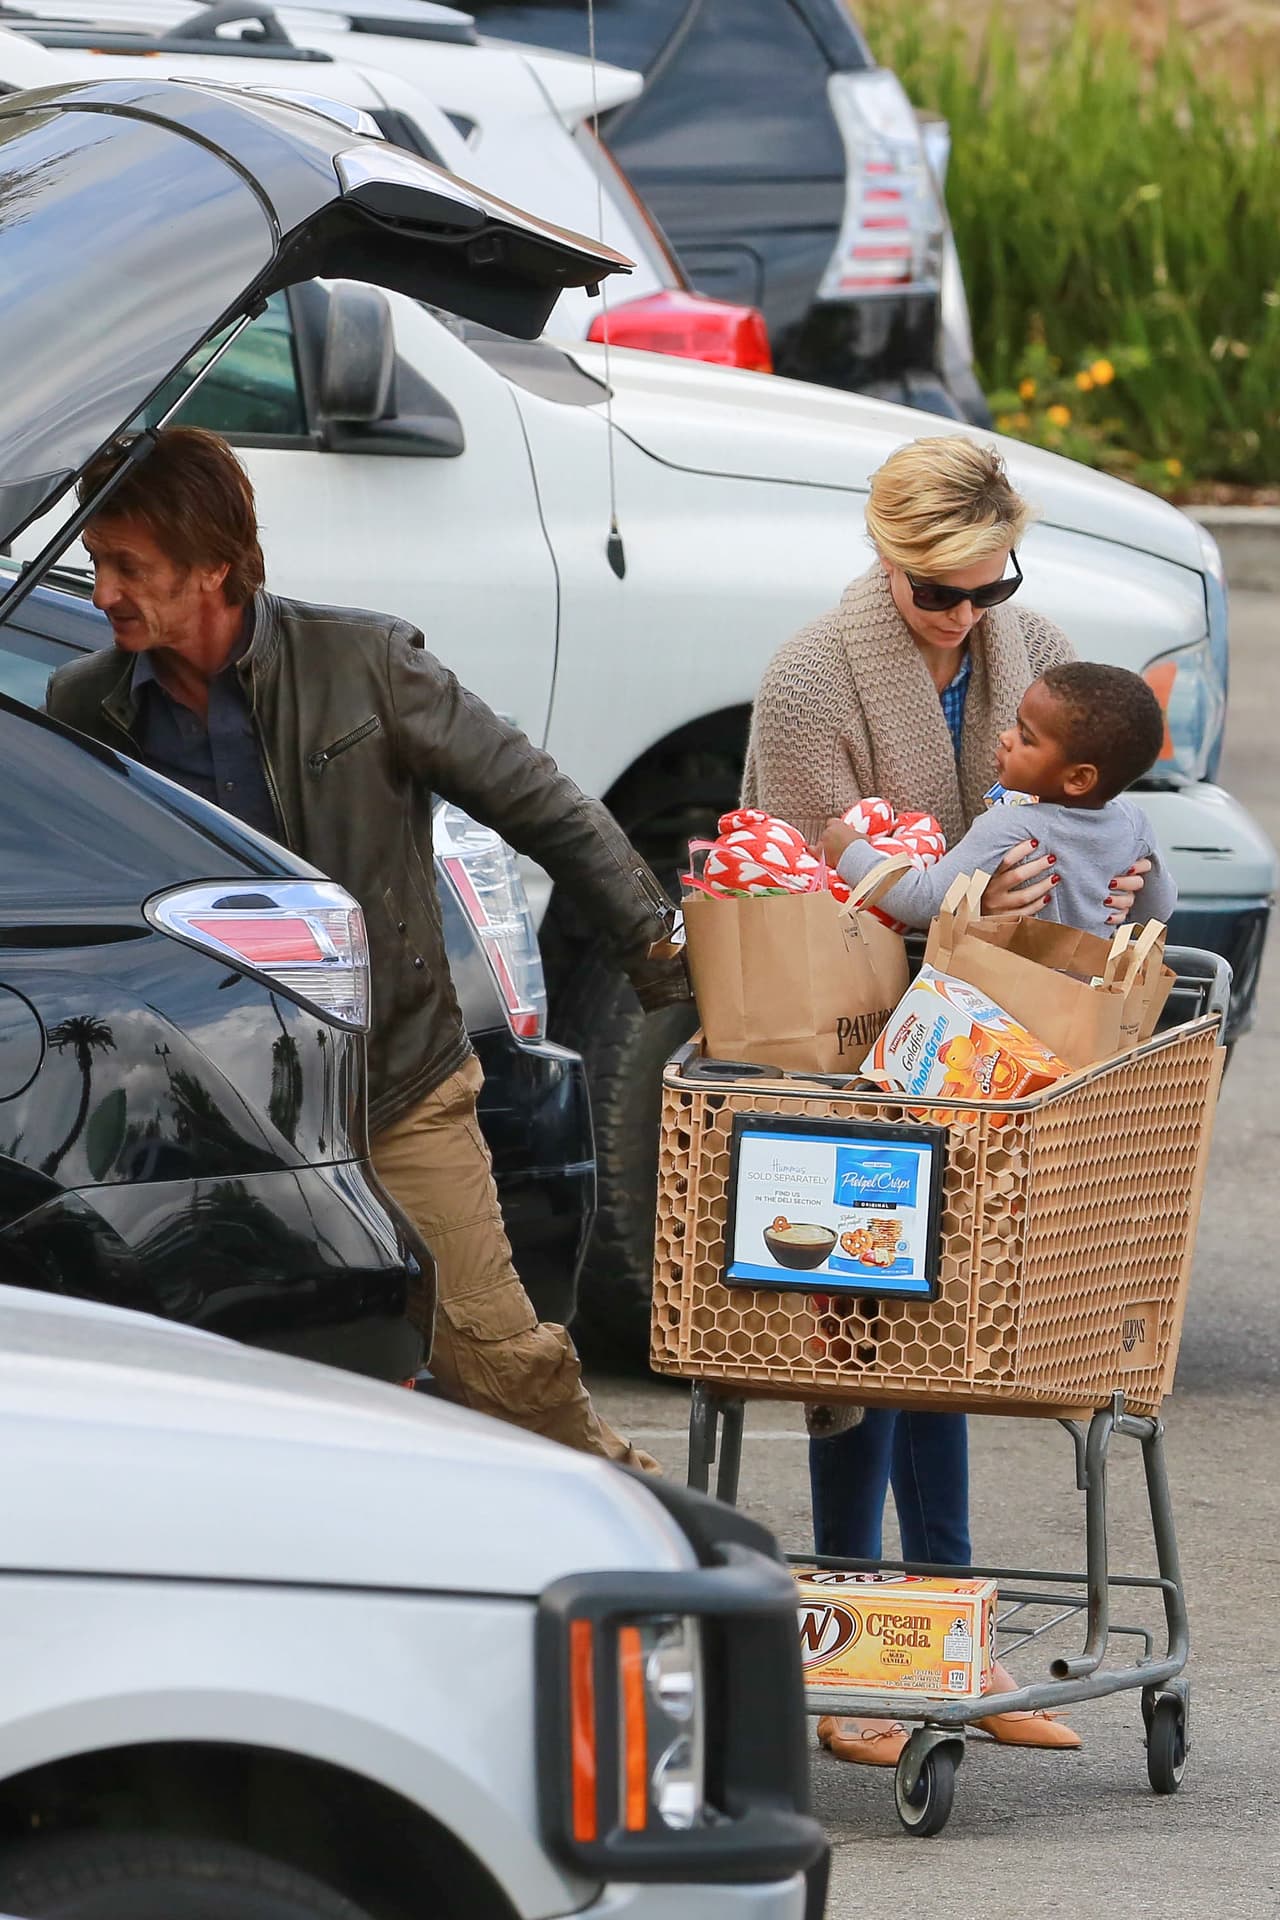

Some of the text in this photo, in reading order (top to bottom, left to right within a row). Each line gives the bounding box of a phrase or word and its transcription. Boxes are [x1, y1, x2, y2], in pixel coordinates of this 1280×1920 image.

[902, 1023, 927, 1072] Goldfish
[747, 1172, 829, 1185] SOLD SEPARATELY
[877, 1172, 911, 1193] Crisps
[793, 1198, 822, 1206] SECTION
[866, 1613, 931, 1636] Cream
[882, 1630, 931, 1648] Soda
[882, 1657, 910, 1665] VANILLA
[951, 1671, 965, 1681] 170
